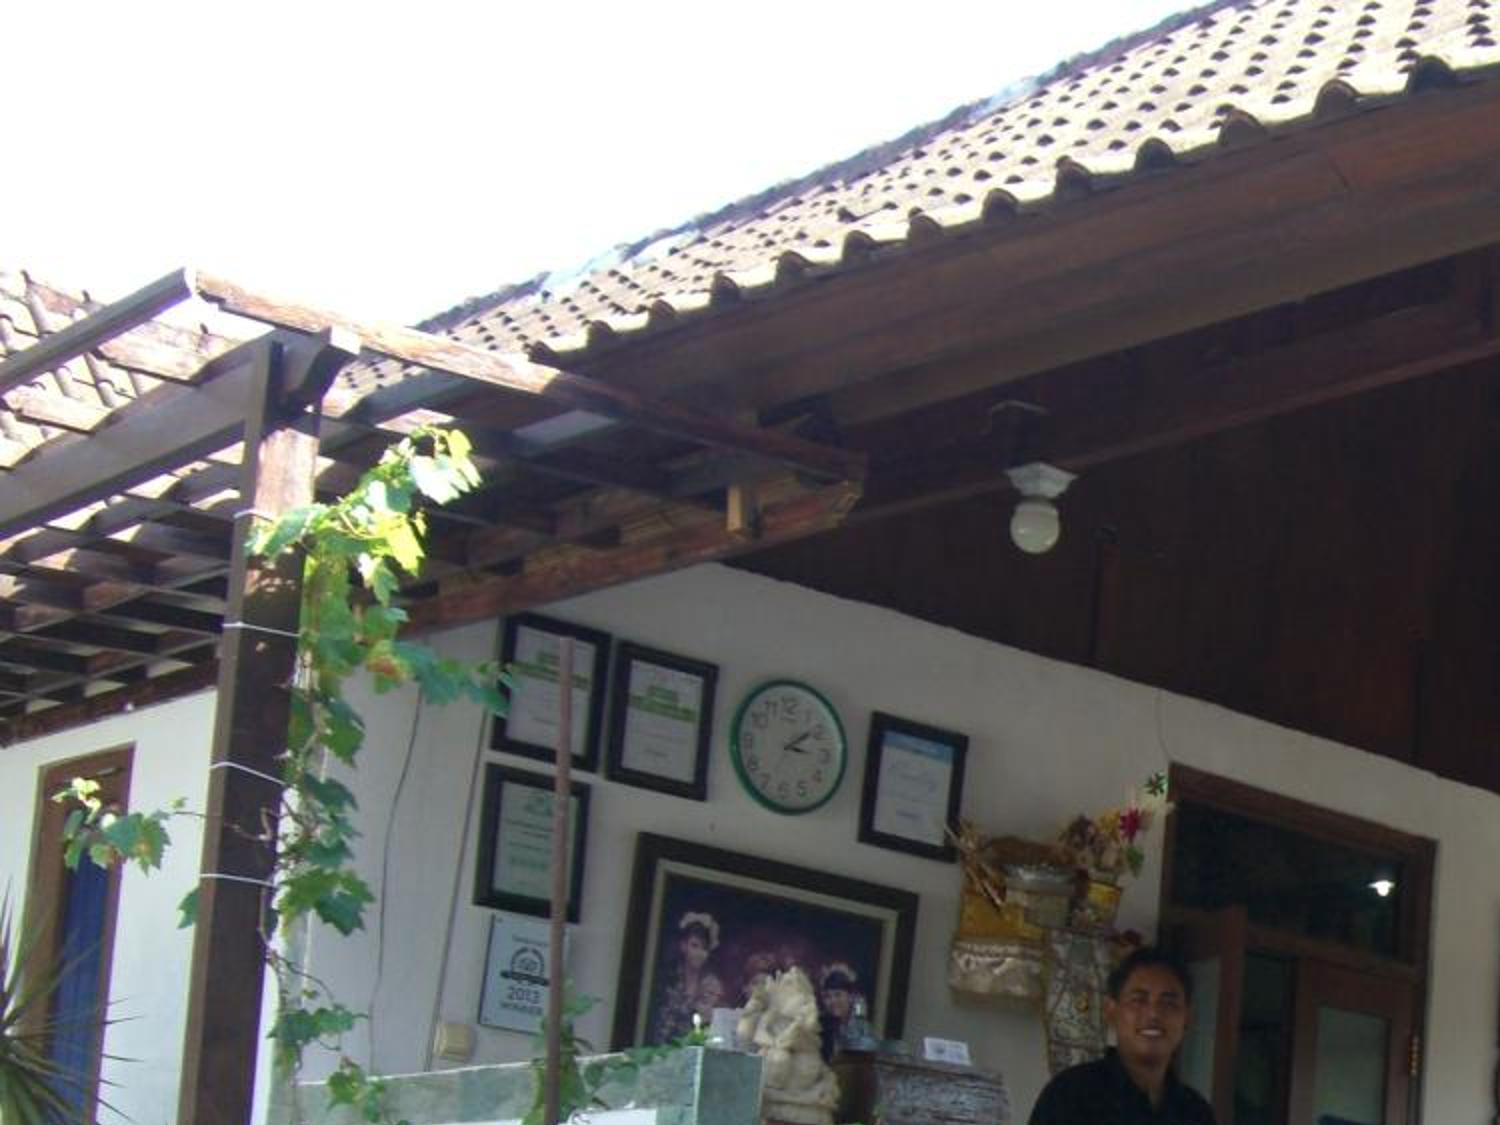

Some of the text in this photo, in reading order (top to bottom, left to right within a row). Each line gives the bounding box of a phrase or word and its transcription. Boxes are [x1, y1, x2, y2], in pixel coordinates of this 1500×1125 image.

[764, 700, 780, 720] 11
[780, 695, 800, 716] 12
[818, 746, 831, 765] 3
[796, 779, 808, 798] 5
